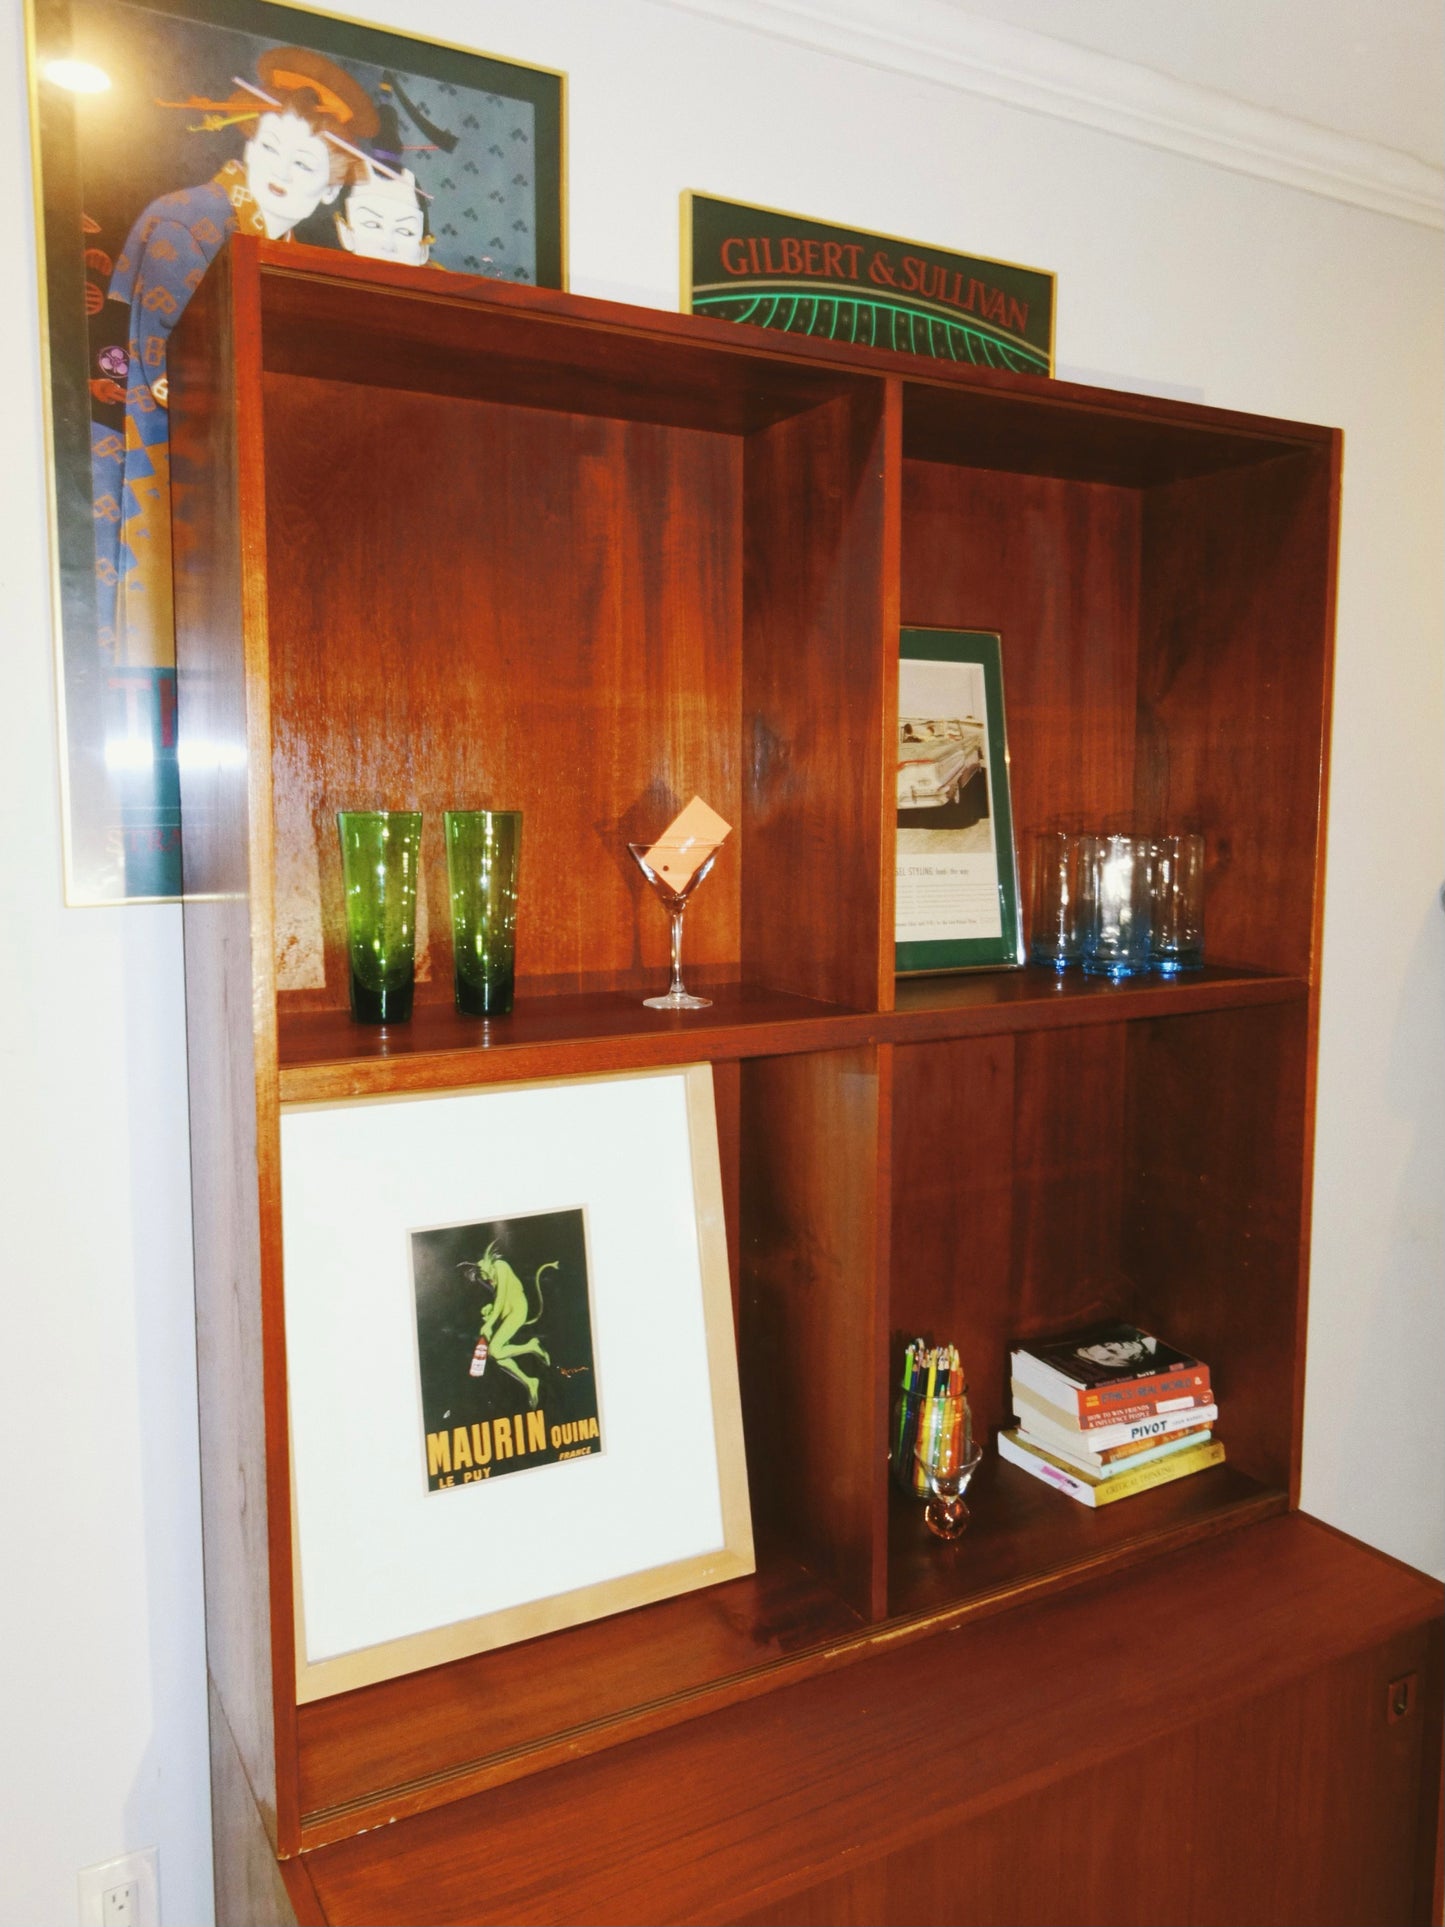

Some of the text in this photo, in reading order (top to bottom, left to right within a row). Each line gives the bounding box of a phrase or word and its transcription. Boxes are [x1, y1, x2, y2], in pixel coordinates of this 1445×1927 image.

[721, 237, 1029, 334] GILBERT & SULLIVAN
[1111, 1409, 1124, 1417] WIN
[1124, 1404, 1150, 1414] FRIENDS
[1095, 1415, 1127, 1427] INFLUENCE
[1131, 1420, 1167, 1438] PIVOT
[427, 1410, 599, 1476] MAURIN QUINA
[559, 1446, 592, 1461] FRANCE
[439, 1467, 491, 1489] LE PUY
